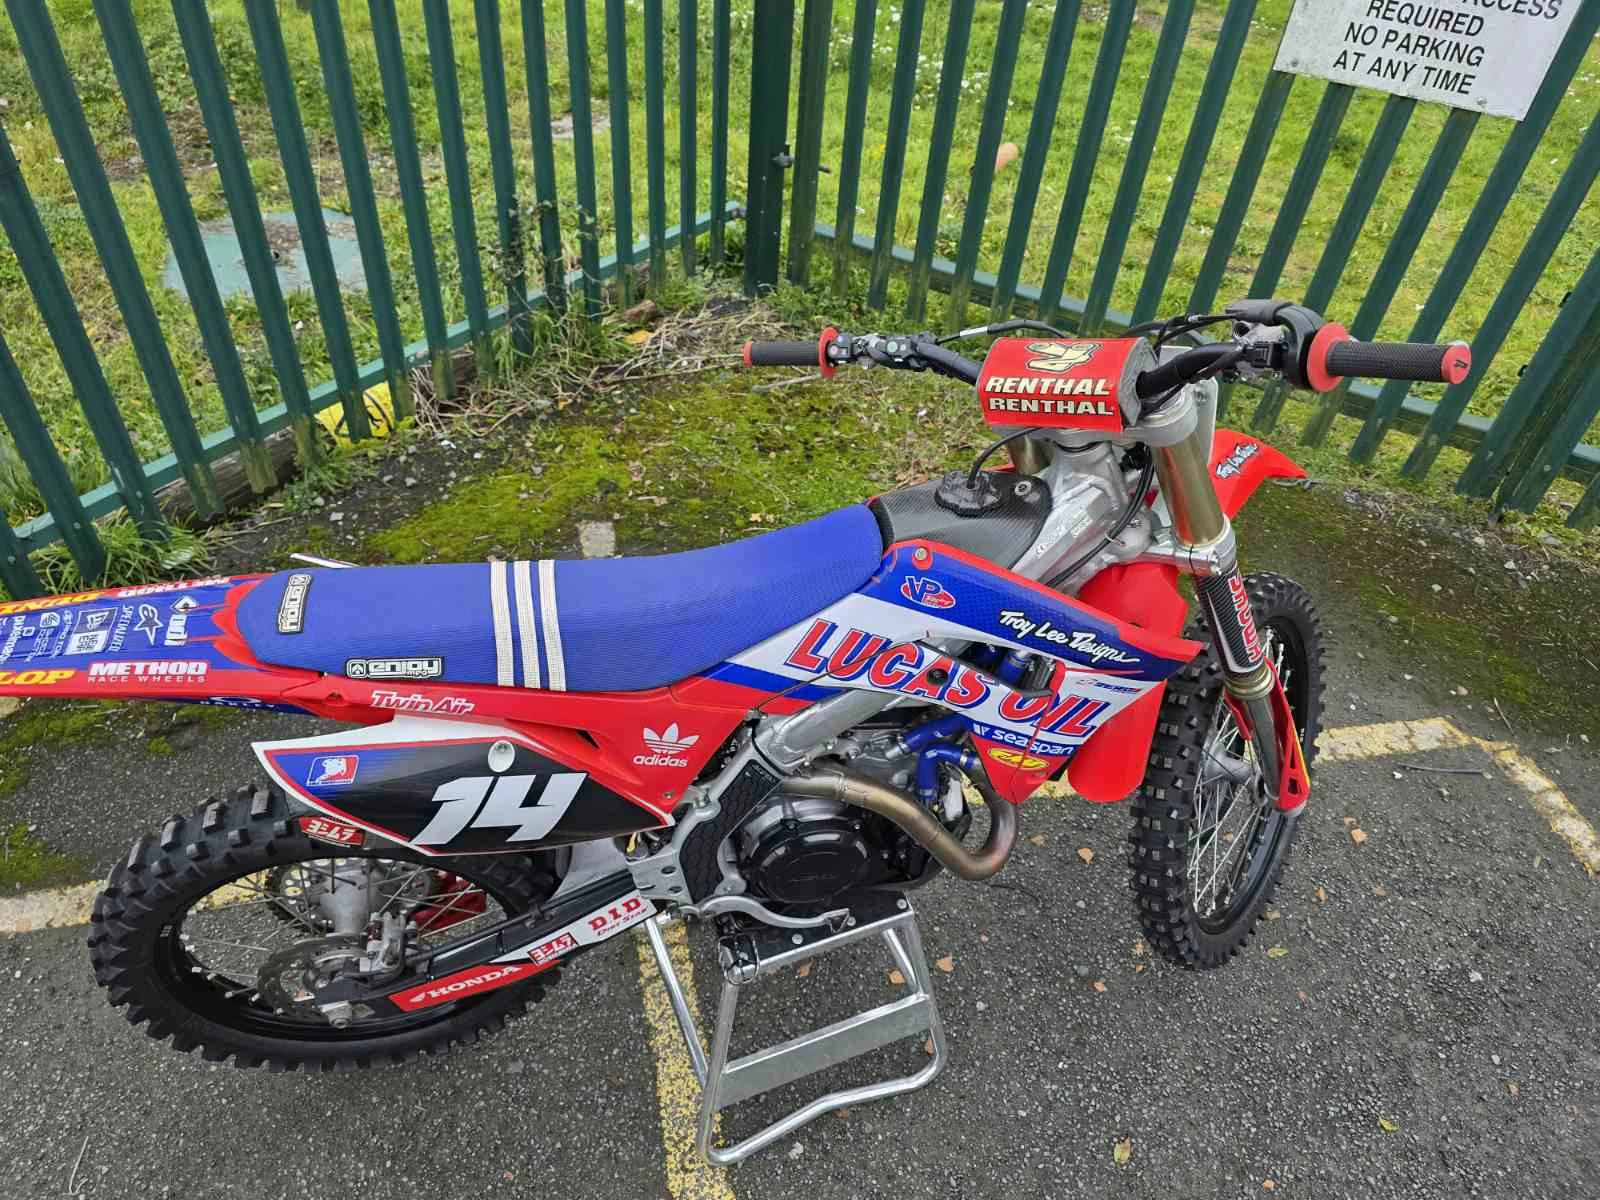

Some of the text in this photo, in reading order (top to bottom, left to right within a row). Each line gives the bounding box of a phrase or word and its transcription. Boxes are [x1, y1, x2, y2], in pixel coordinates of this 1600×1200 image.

[1366, 0, 1485, 37] REQUIRED
[1462, 0, 1562, 20] CESS
[1344, 22, 1485, 67] NO PARKING
[1333, 50, 1476, 95] AT ANY TIME
[984, 376, 1115, 395] RENTHAL
[989, 397, 1115, 416] RENTHAL
[904, 575, 943, 600] VP
[1000, 610, 1141, 663] Troy Lee Designs
[88, 675, 206, 684] RACE WHEELS
[89, 661, 208, 676] METHOD
[784, 618, 1110, 738] LUCAS OIL
[991, 729, 1075, 755] seaspan
[632, 753, 689, 768] adidas
[408, 772, 587, 846] 14
[427, 966, 522, 998] HONDA
